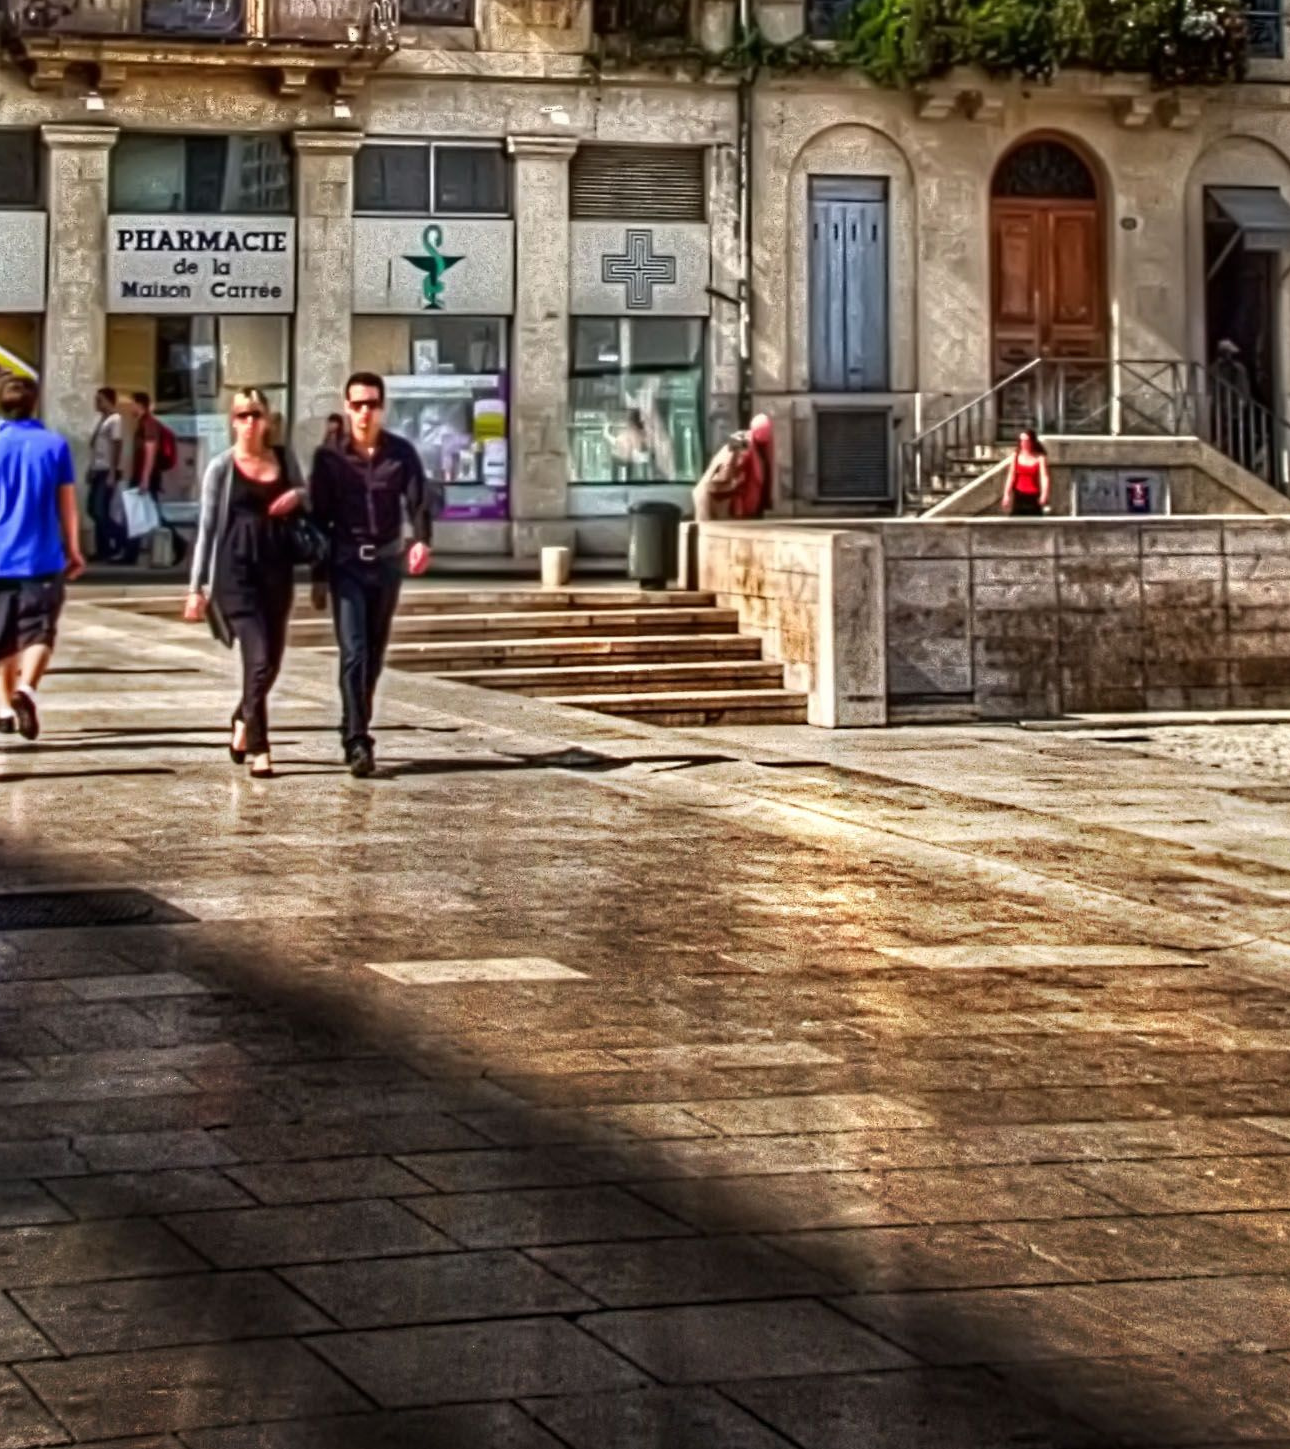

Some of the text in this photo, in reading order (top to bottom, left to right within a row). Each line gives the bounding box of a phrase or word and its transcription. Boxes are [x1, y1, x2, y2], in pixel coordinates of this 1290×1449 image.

[117, 229, 287, 252] PHARMACIE
[173, 257, 231, 275] de la
[121, 281, 282, 298] Maison Carrée
